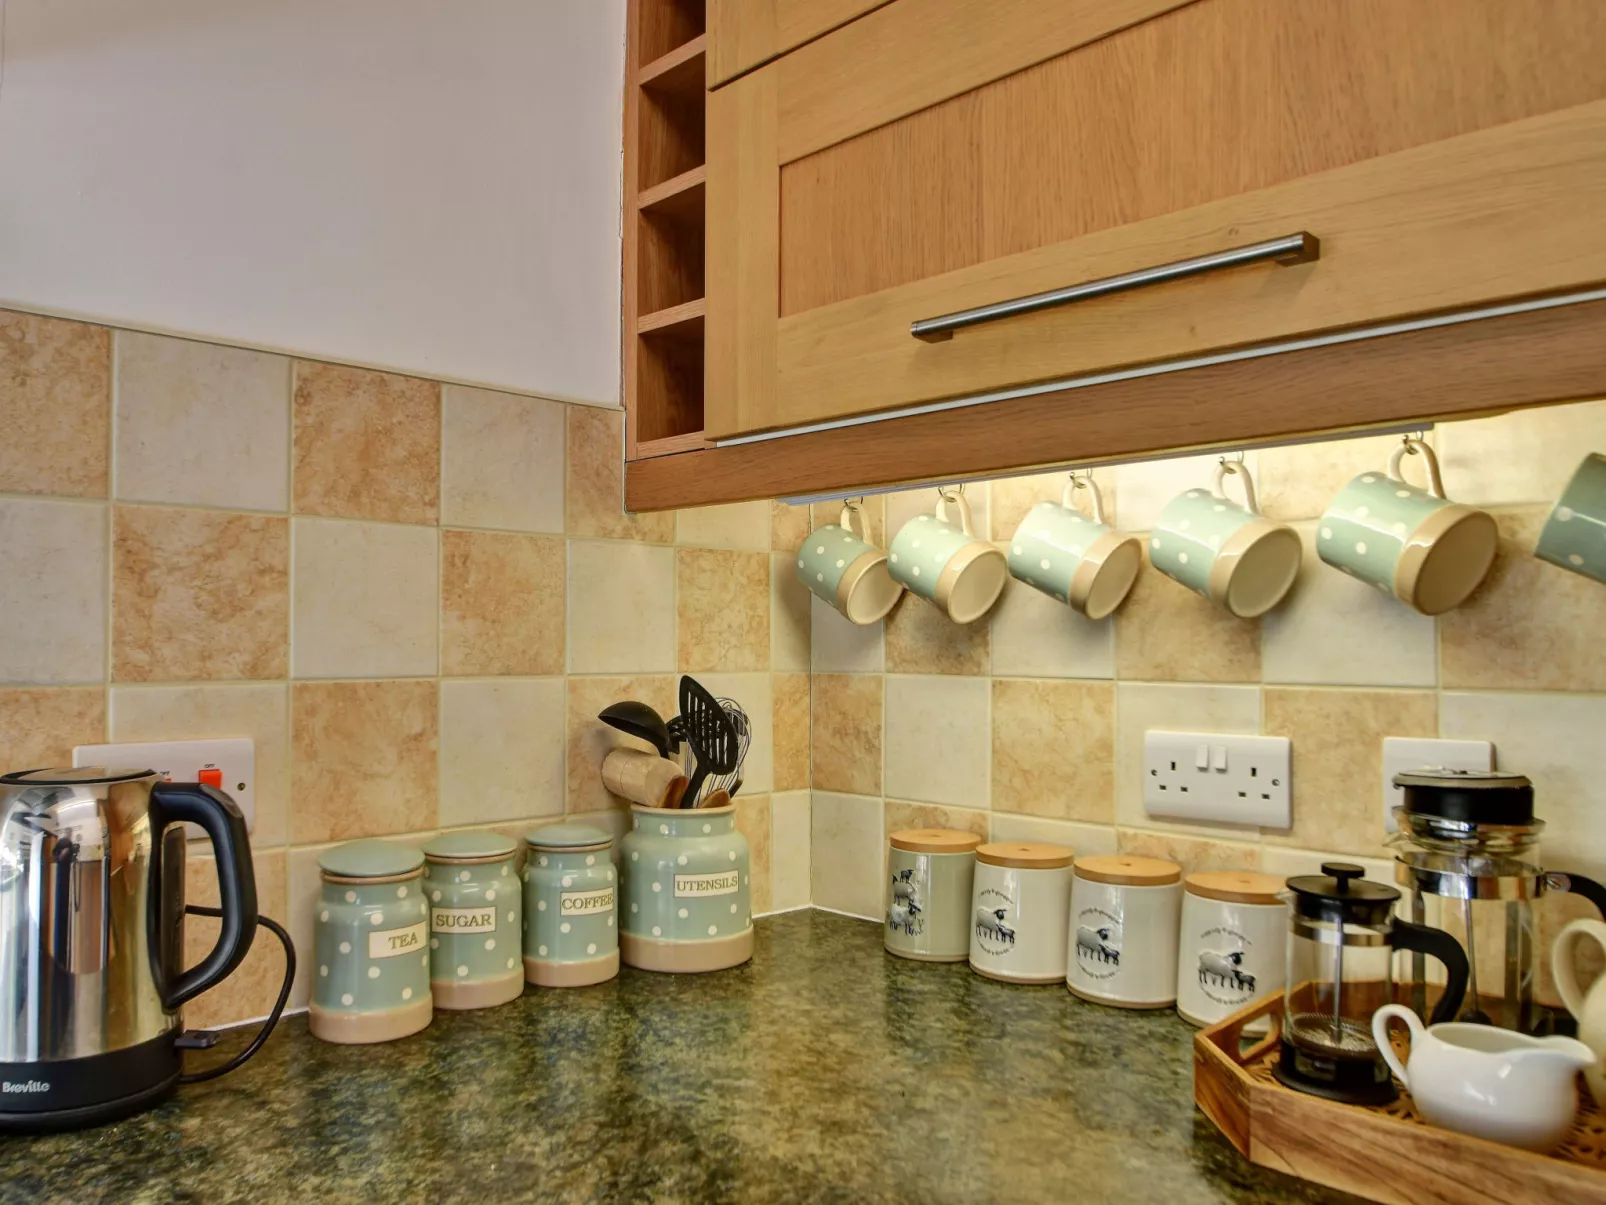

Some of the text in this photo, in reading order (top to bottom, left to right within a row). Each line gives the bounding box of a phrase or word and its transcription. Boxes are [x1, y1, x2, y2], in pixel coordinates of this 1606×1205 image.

[675, 876, 738, 892] UTENSILS
[561, 894, 614, 911] COFFEE
[435, 913, 493, 929] SUGAR
[388, 933, 419, 951] TEA
[2, 1079, 51, 1094] Breville
